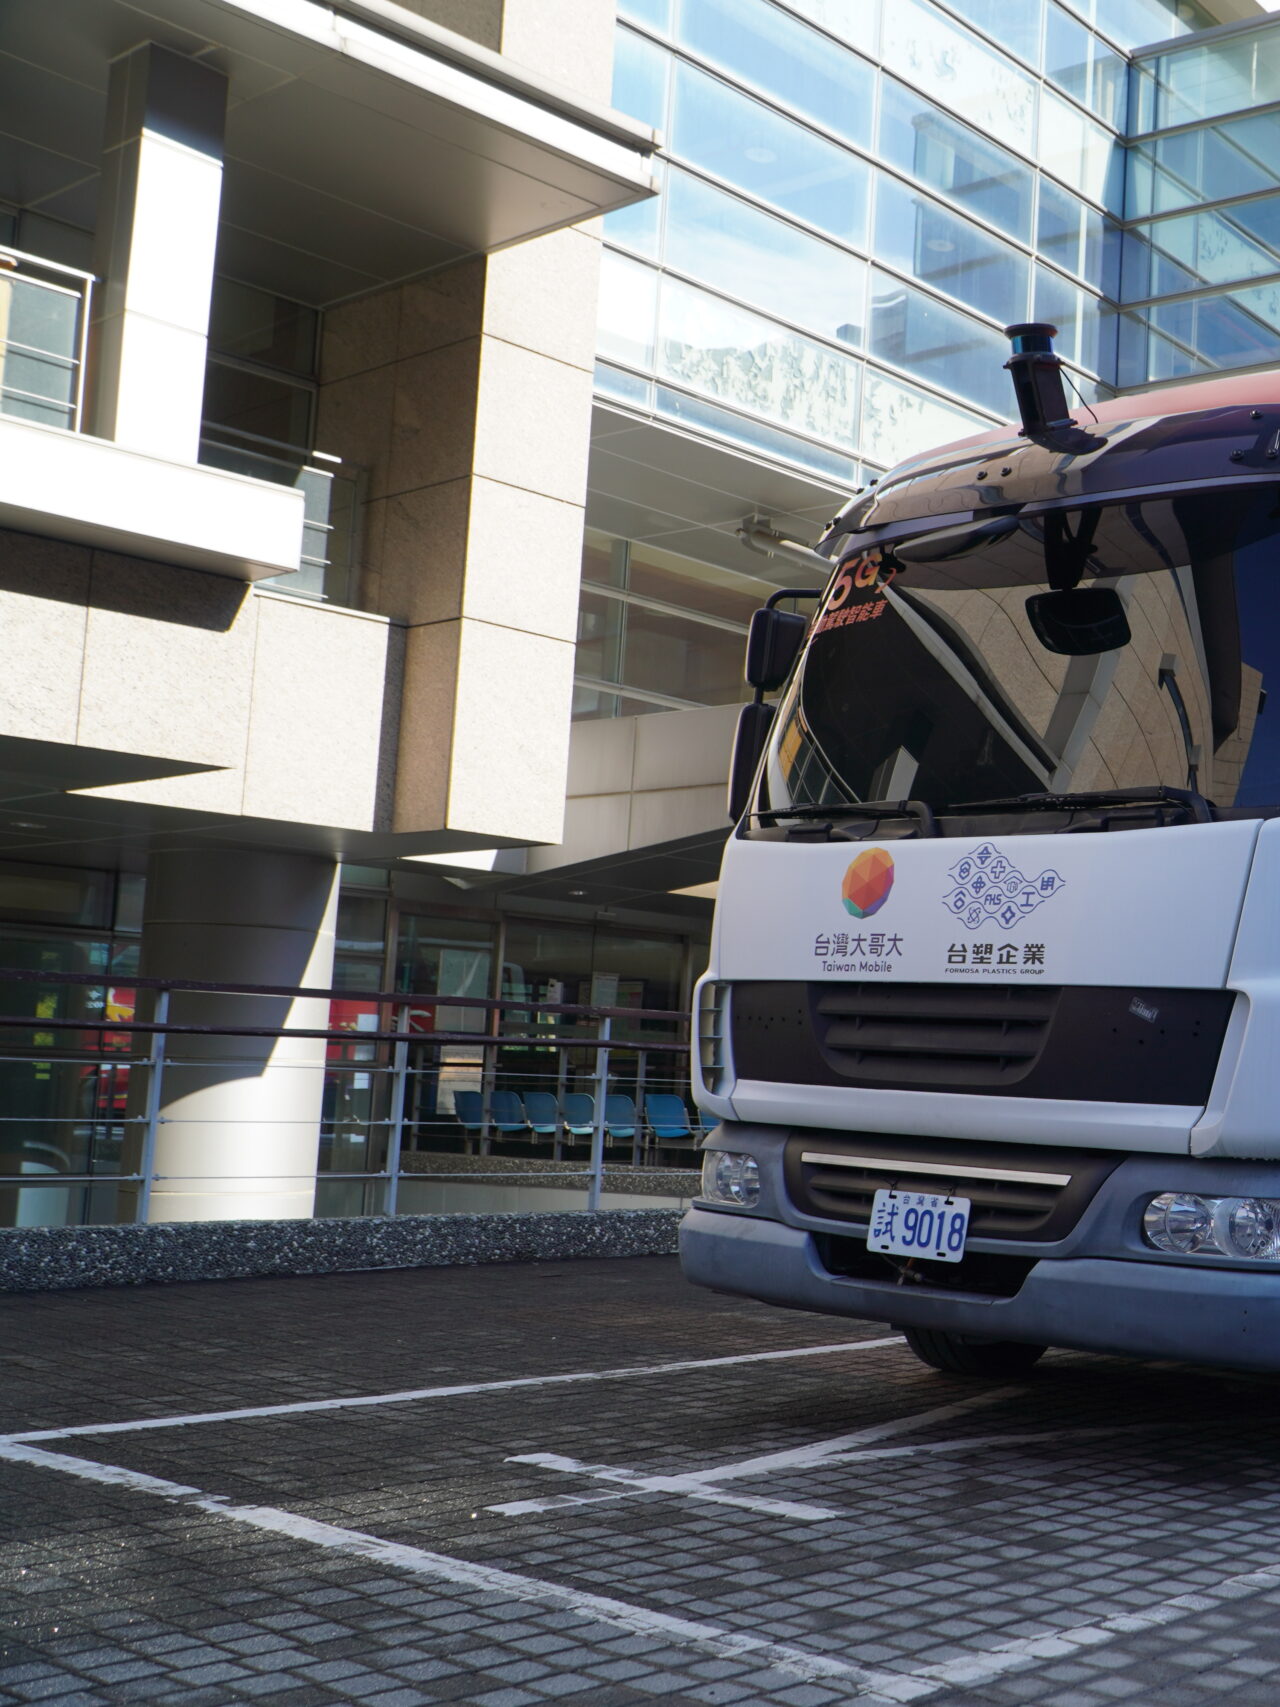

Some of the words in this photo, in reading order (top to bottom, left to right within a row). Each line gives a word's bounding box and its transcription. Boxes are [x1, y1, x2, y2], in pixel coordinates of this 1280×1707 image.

[827, 552, 882, 611] 5G
[814, 933, 904, 957] 台灣大哥大
[947, 943, 1045, 965] 台塑企業
[822, 960, 857, 972] Taiwan
[859, 960, 892, 972] Mobile
[873, 1202, 899, 1243] 試
[902, 1207, 966, 1252] 9018
